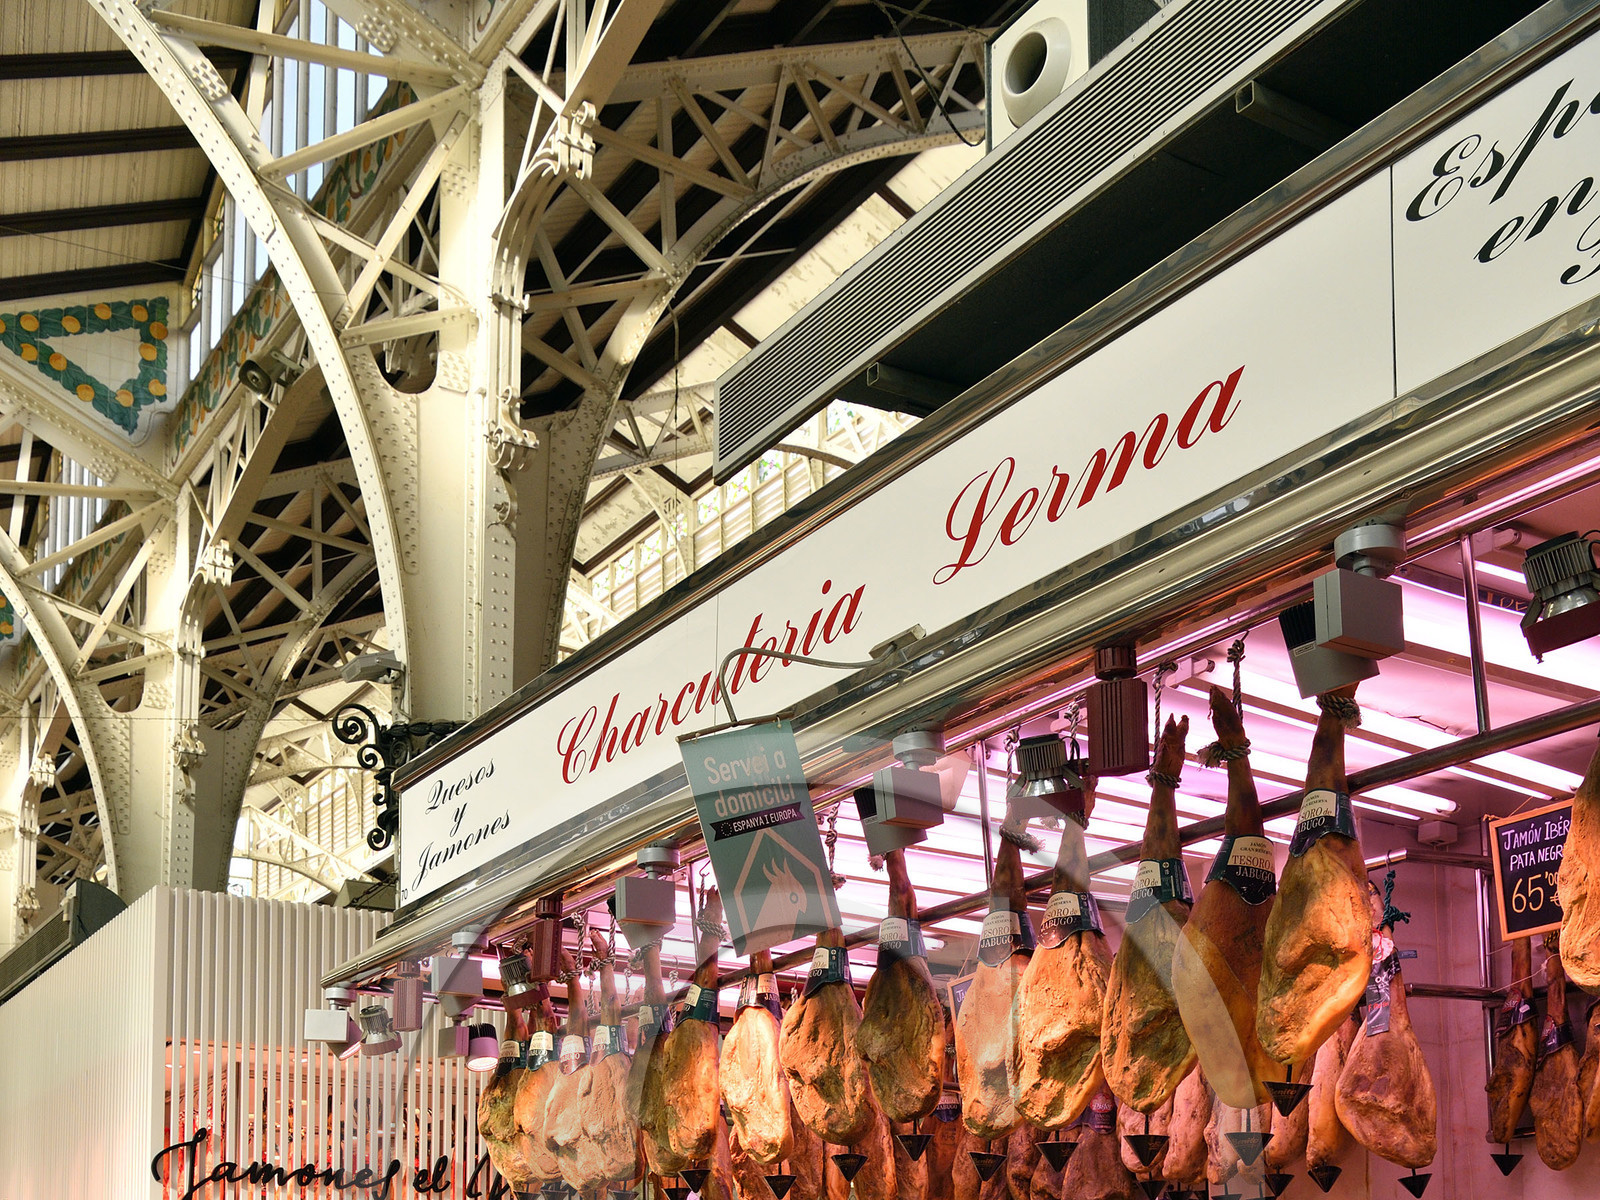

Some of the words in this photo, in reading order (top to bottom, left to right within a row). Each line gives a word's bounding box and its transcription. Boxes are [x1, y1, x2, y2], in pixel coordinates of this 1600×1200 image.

[1406, 78, 1600, 222] Esp
[557, 579, 867, 784] Charcuteria
[933, 364, 1246, 585] Lerma
[703, 745, 770, 785] Servei
[773, 749, 787, 769] a
[424, 758, 497, 815] Quesos
[714, 774, 796, 818] domicili
[449, 802, 468, 838] y
[733, 816, 764, 833] ESPANYA
[765, 815, 770, 825] I
[769, 808, 798, 824] EUROPA
[1501, 823, 1542, 851] JAMÓN
[1544, 815, 1571, 841] IBÉR
[411, 808, 511, 892] Jamones
[1232, 854, 1271, 870] TESORO
[1510, 851, 1536, 871] PATA
[1537, 844, 1564, 863] NEGR
[1235, 866, 1273, 883] JABUGO
[980, 934, 1014, 949] JABUGO
[412, 1154, 453, 1194] el
